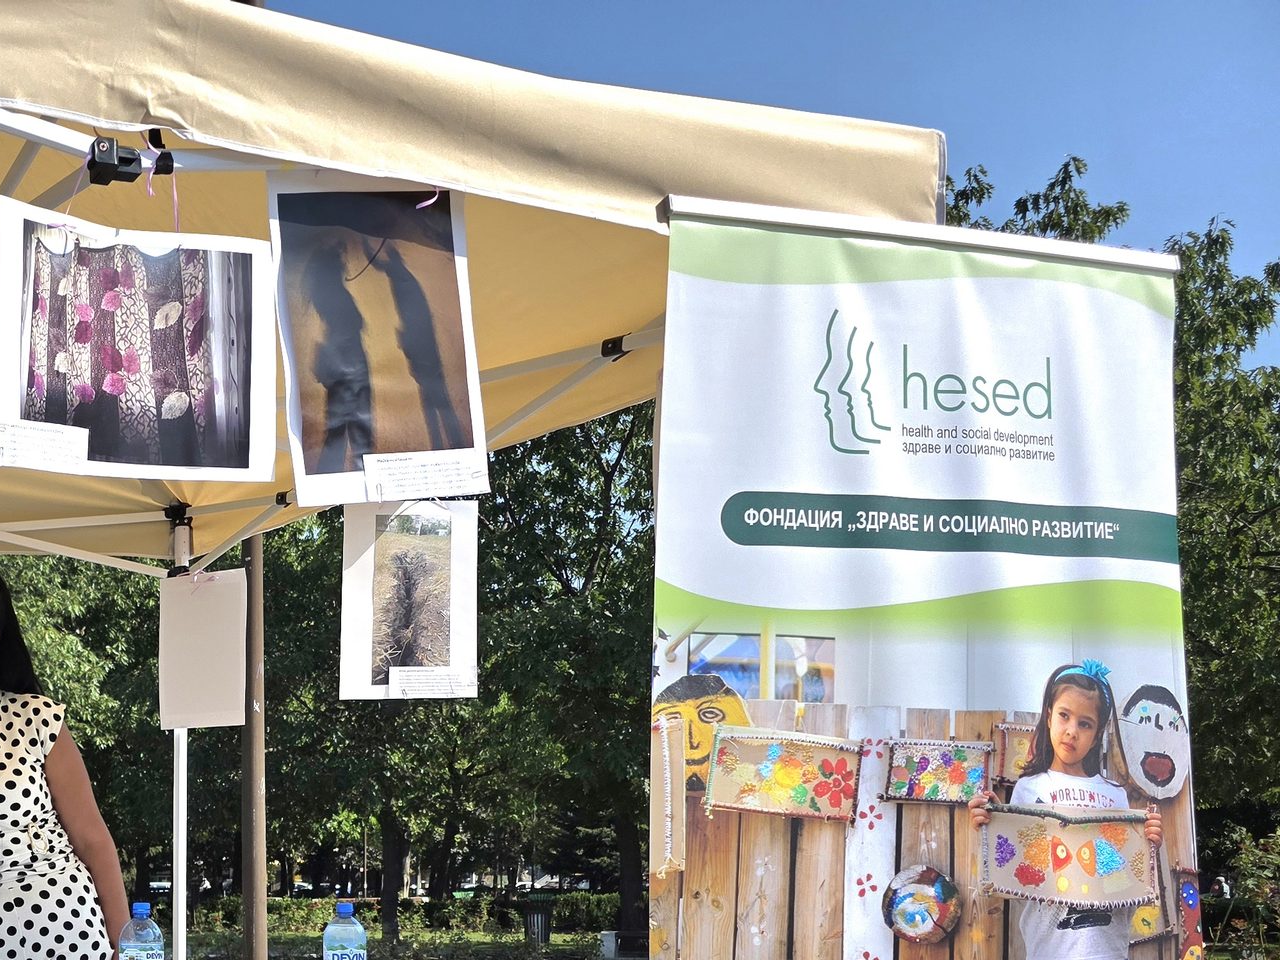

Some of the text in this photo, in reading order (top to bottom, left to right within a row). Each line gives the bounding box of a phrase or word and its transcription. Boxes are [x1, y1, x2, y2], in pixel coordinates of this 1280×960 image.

[902, 343, 1052, 420] hesed
[901, 423, 1054, 447] health and social development
[902, 441, 1056, 462] здраве и социално развитие
[743, 507, 1120, 540] ФОНДАЦИЯ „ЗДРАВЕ И СОЦИАЛНО РАЗВИТИЕ“
